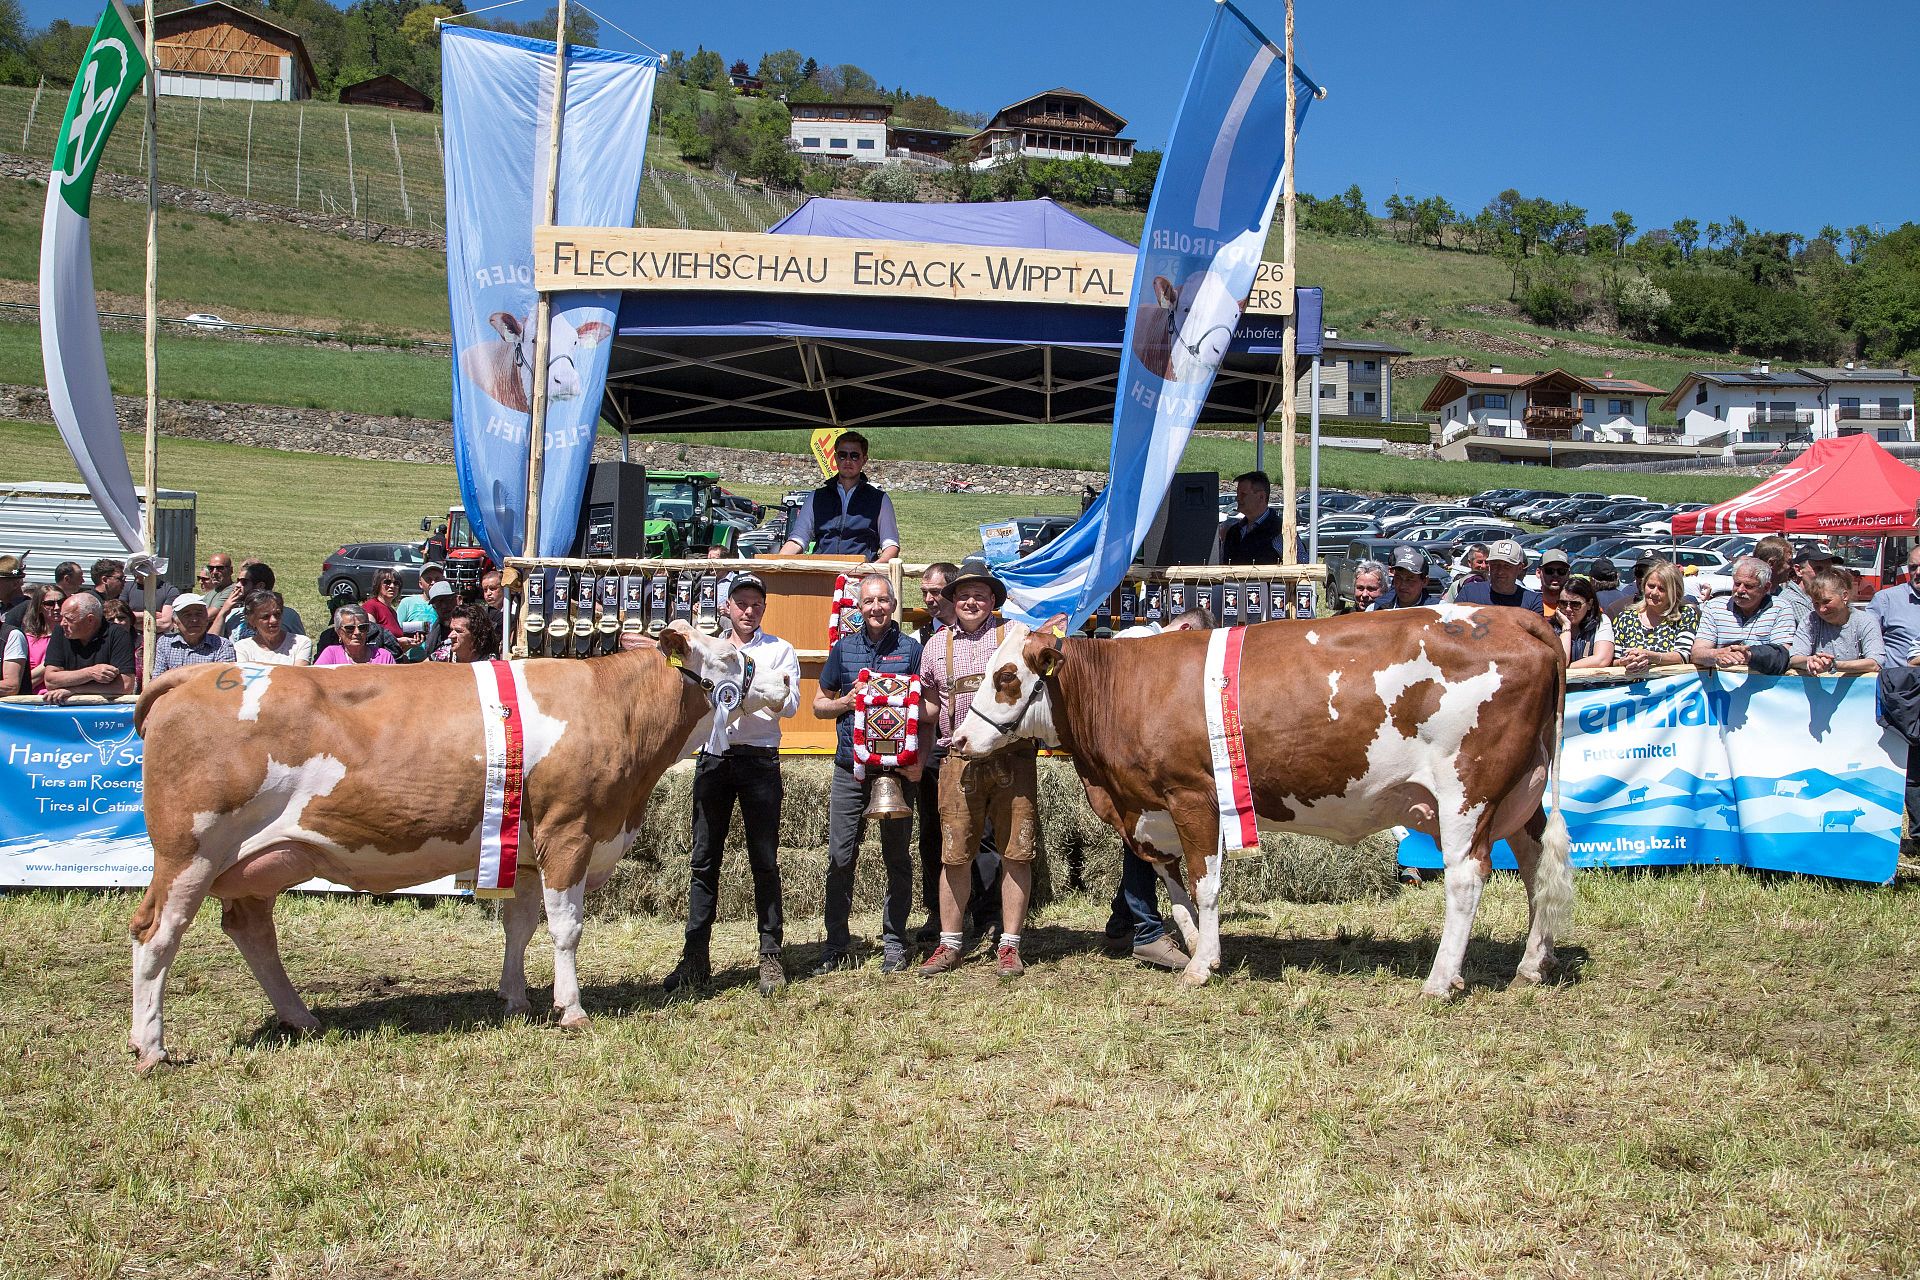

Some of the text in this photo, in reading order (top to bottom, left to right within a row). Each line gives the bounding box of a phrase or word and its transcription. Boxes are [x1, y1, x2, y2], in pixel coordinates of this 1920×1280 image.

[552, 241, 829, 283] FLECKVIEHSCHAU
[853, 251, 1124, 296] EISACK-WIPPTAL
[1818, 514, 1904, 527] www.hofer.it
[216, 667, 266, 691] 67
[1578, 683, 1732, 735] enzian
[94, 721, 115, 730] 1937
[8, 743, 93, 769] Haniger
[1583, 742, 1677, 762] Futtermittel
[27, 773, 144, 792] Tiers am Roseng
[35, 797, 145, 814] Tires al Catinac
[26, 863, 154, 874] www.hanigerschwaige.co
